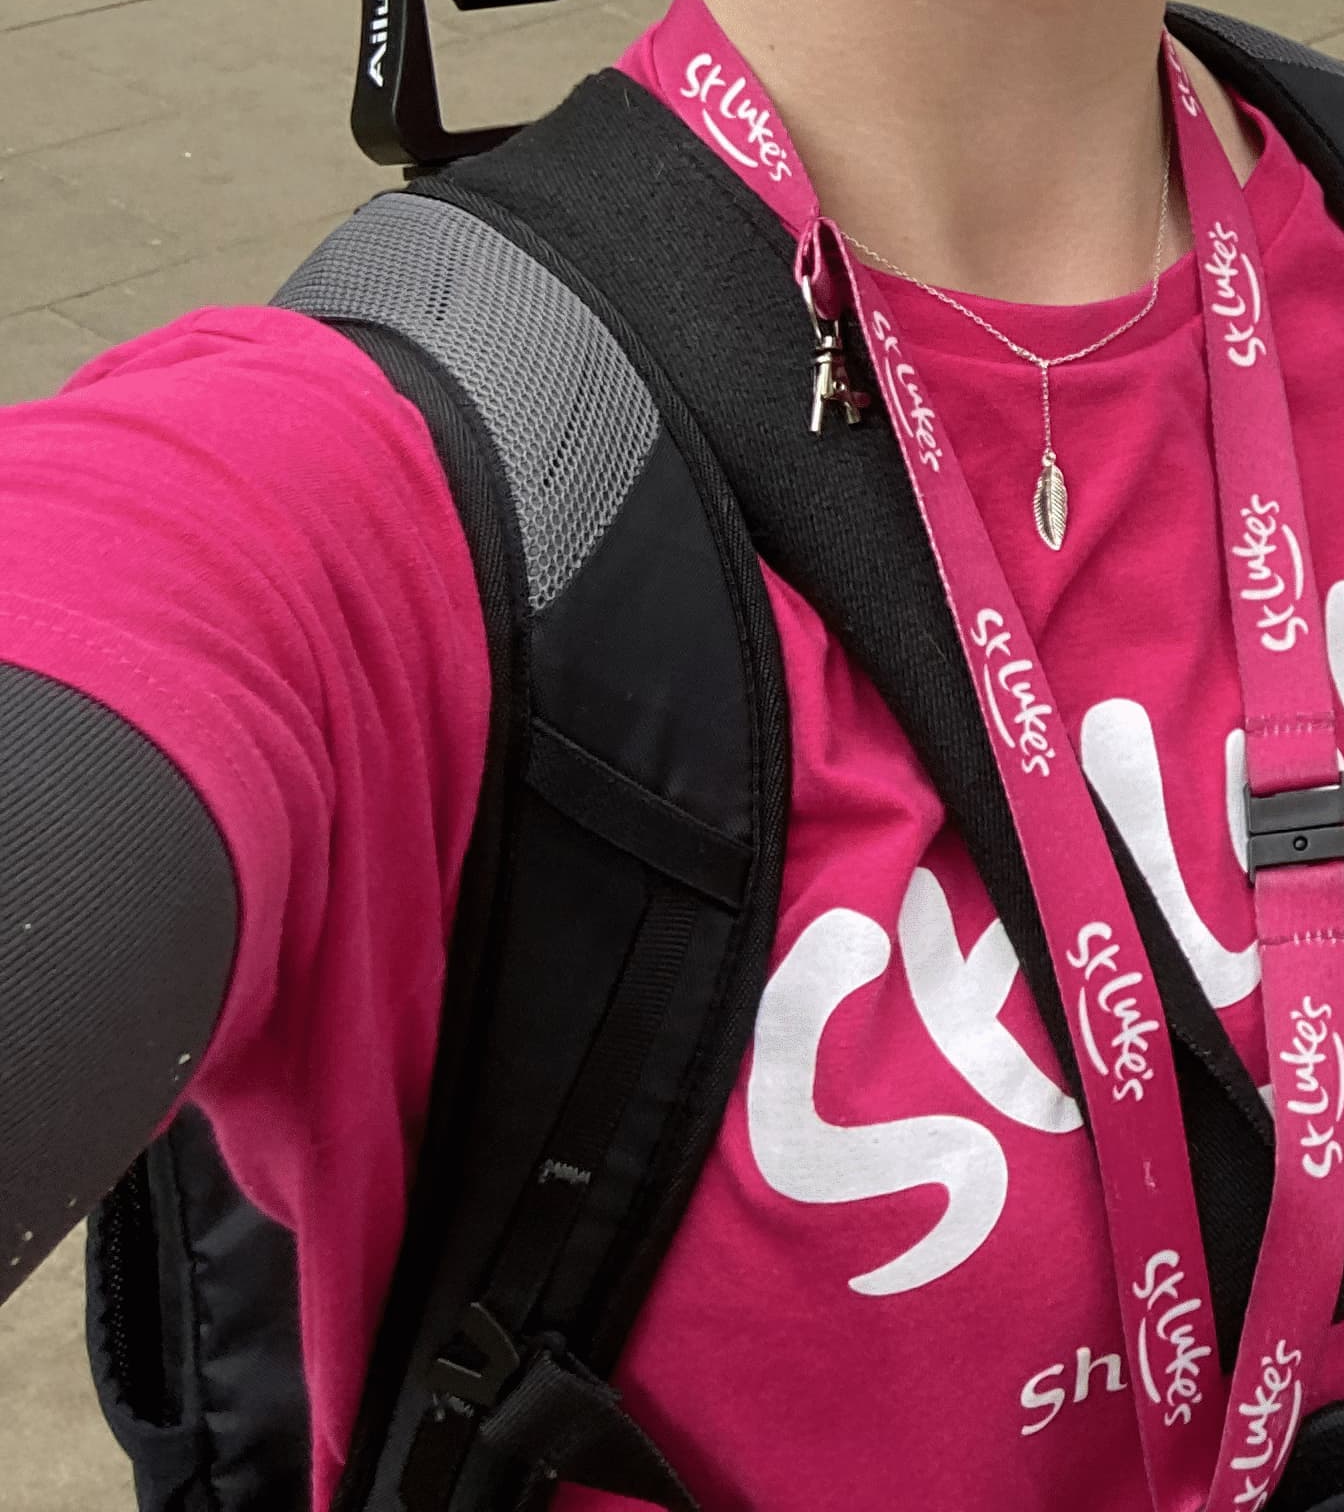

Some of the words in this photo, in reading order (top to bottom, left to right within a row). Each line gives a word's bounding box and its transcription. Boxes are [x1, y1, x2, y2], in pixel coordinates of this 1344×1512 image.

[680, 53, 723, 104] St
[720, 76, 793, 182] Luke's
[1203, 221, 1246, 319] Luke's
[870, 310, 903, 364] St
[897, 361, 941, 474] Luke's
[1224, 319, 1268, 367] St
[1232, 494, 1287, 601] Luke's
[970, 607, 1012, 663] St
[1000, 658, 1051, 778] Luke's
[1255, 605, 1309, 653] St
[1066, 920, 1119, 982] St
[1098, 971, 1161, 1102] Luke's
[1280, 995, 1333, 1122] Luke's
[1299, 1123, 1344, 1179] St
[1132, 1249, 1185, 1303] St
[1155, 1298, 1212, 1426] Luke's
[1229, 1339, 1303, 1473] Luke's
